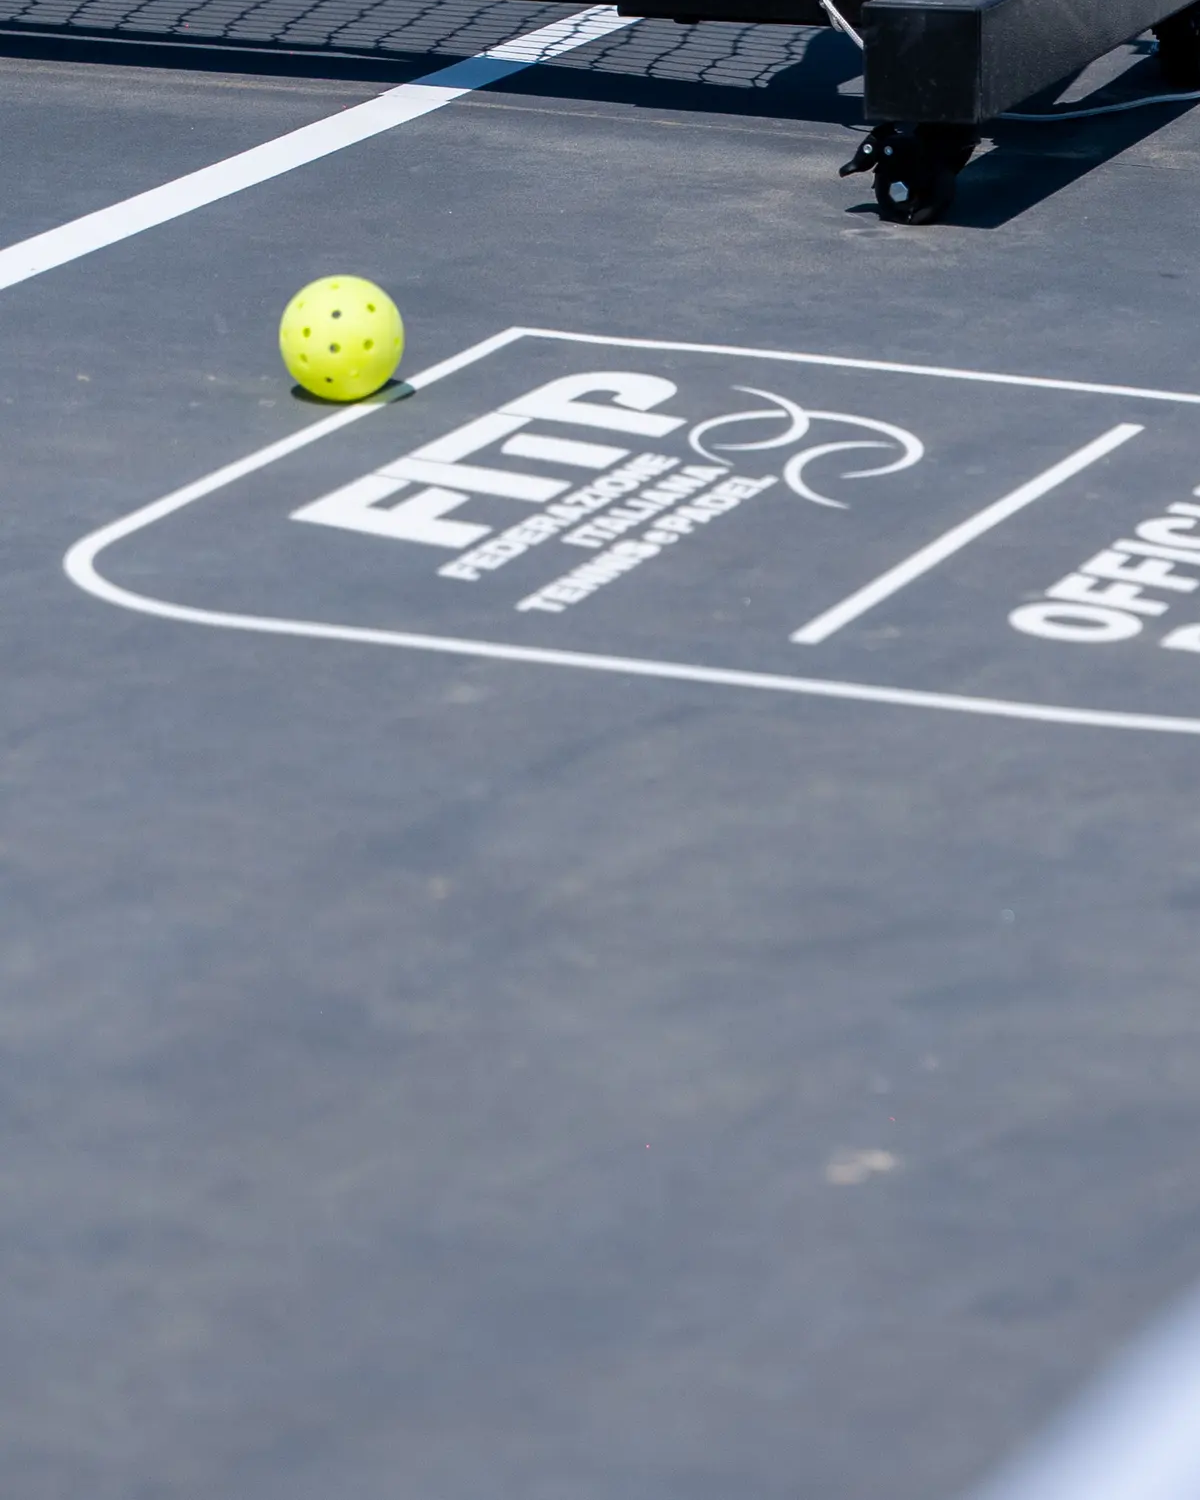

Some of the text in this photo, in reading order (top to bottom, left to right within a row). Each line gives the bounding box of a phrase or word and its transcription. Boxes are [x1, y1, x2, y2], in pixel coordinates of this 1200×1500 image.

[437, 453, 682, 580] FEDERAZIONE
[515, 540, 662, 613] TENNIS
[653, 474, 779, 534] PADEL
[561, 465, 731, 549] ITALIANA
